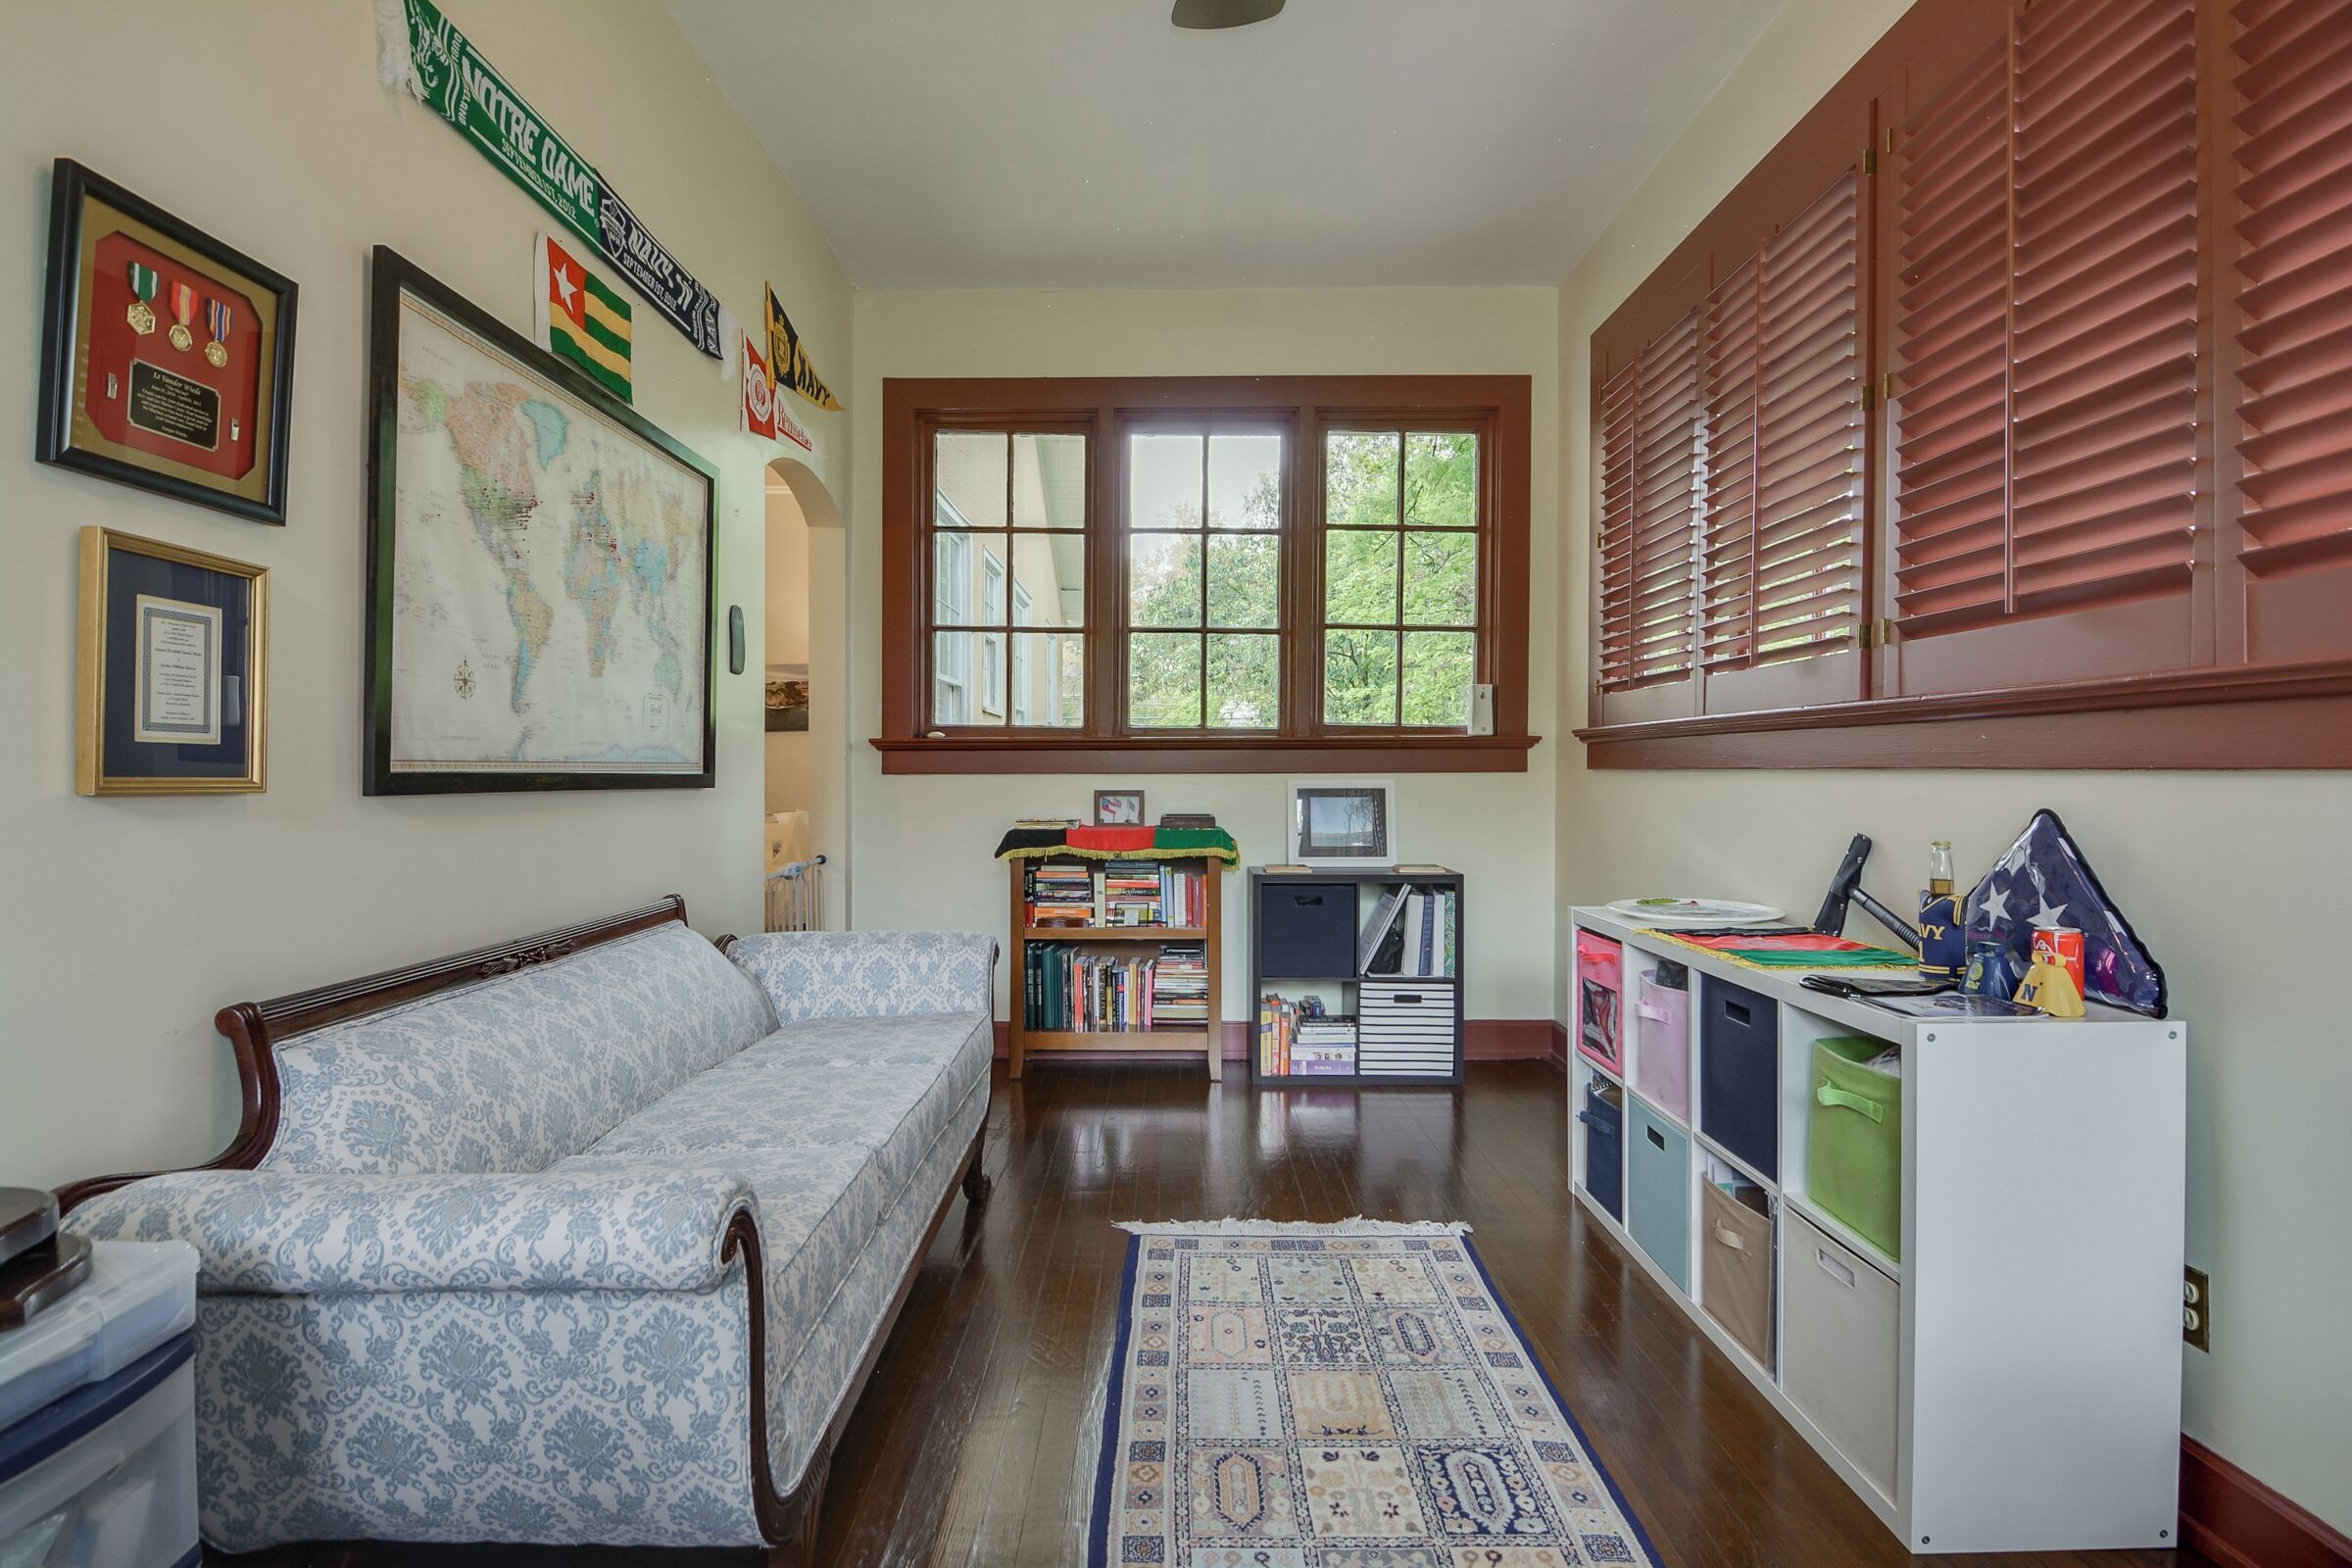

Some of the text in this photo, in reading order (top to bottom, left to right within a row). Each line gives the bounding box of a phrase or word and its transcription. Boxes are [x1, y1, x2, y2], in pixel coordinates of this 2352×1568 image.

[451, 32, 471, 125] DUBL RELAND
[463, 56, 595, 217] NOTRE DAME
[502, 138, 544, 189] SEPTEMBER
[558, 193, 576, 220] 2012
[623, 253, 656, 289] SEPTEMBER
[798, 350, 831, 406] NAVY
[1918, 923, 1945, 940] VY
[2021, 984, 2038, 1002] N
